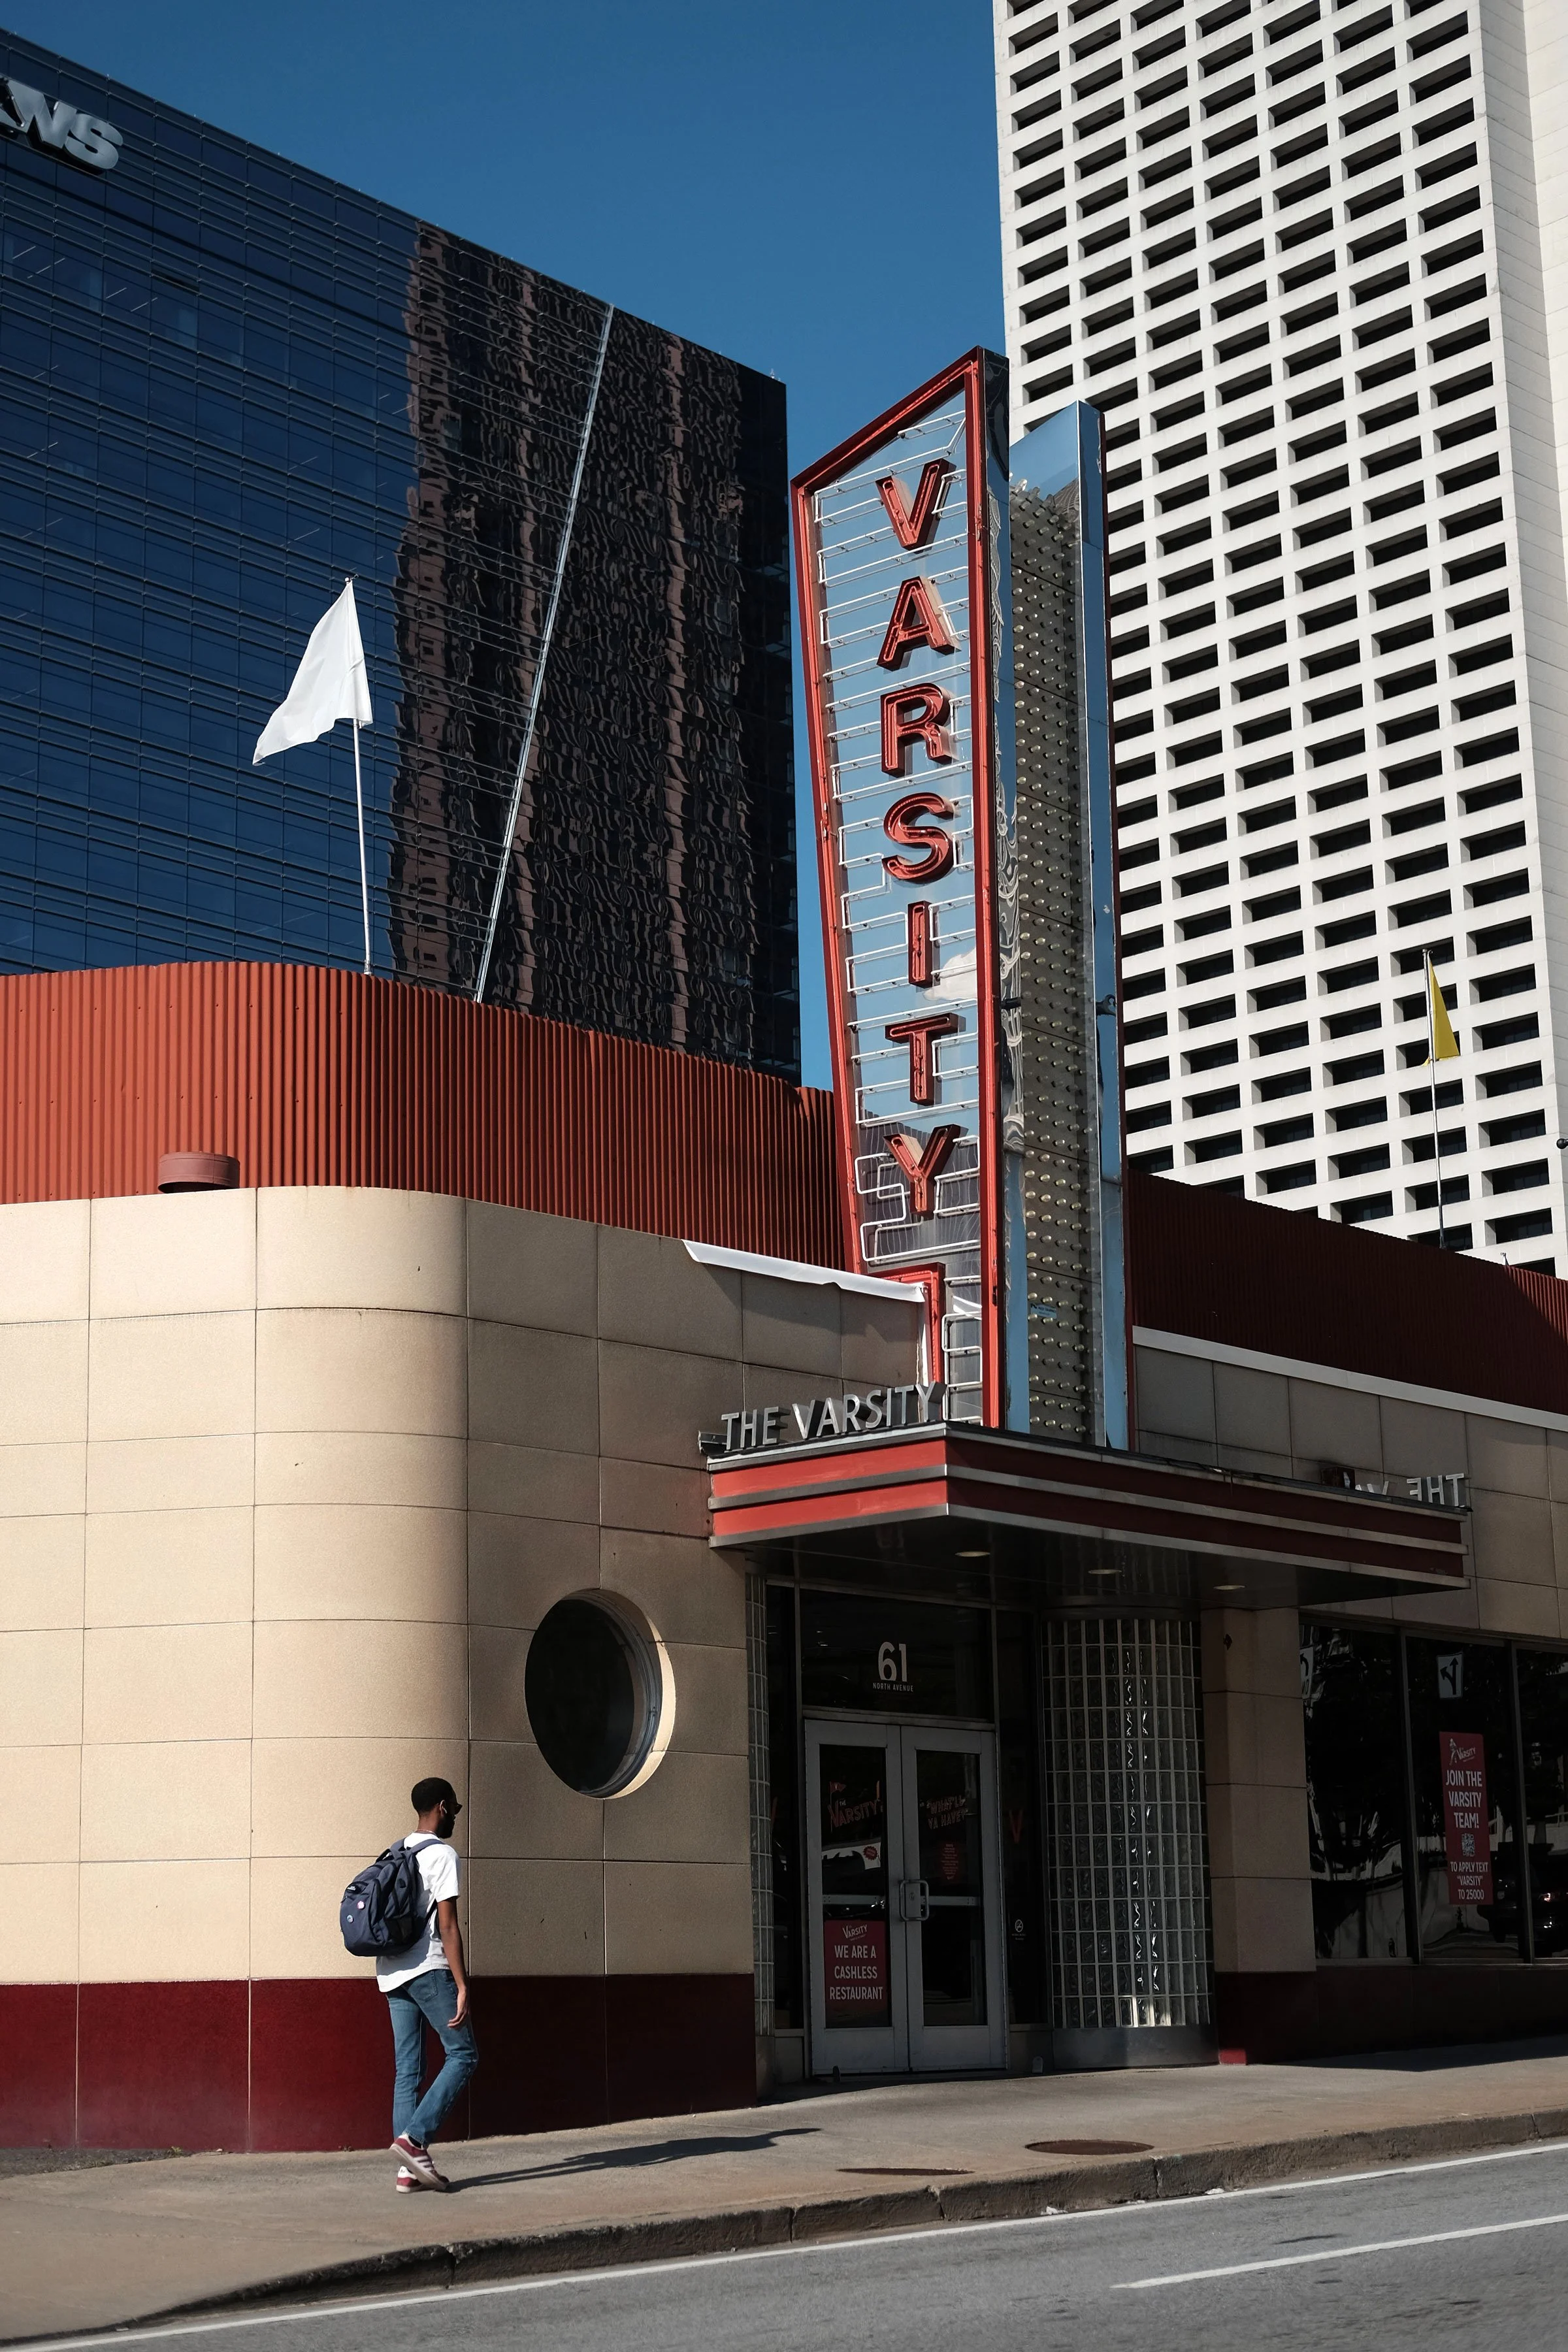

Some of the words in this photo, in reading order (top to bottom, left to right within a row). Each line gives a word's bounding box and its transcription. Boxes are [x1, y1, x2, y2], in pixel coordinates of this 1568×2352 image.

[875, 458, 963, 1217] VARSITY
[721, 1406, 779, 1450] THE
[792, 1380, 937, 1439] VARSITY
[878, 1641, 907, 1682] 61
[872, 1682, 890, 1691] NORTH
[892, 1684, 914, 1692] AVENUE
[1446, 1769, 1465, 1787] JOIN
[1466, 1771, 1482, 1787] THE
[1448, 1791, 1482, 1808] VARSITY
[827, 1799, 877, 1827] VARSITY
[1453, 1812, 1479, 1829] TEAM!
[1450, 1861, 1458, 1872] TO
[1459, 1861, 1475, 1872] APPLY
[1476, 1862, 1488, 1872] TEXT
[1458, 1889, 1465, 1900] TO
[1466, 1889, 1484, 1900] 25000
[842, 1924, 868, 1939] VARSITY
[834, 1945, 849, 1958] WE
[851, 1945, 868, 1958] ARE
[870, 1945, 877, 1958] A
[834, 1965, 878, 1979] CASHLESS
[829, 1986, 883, 2000] RESTAURANT
